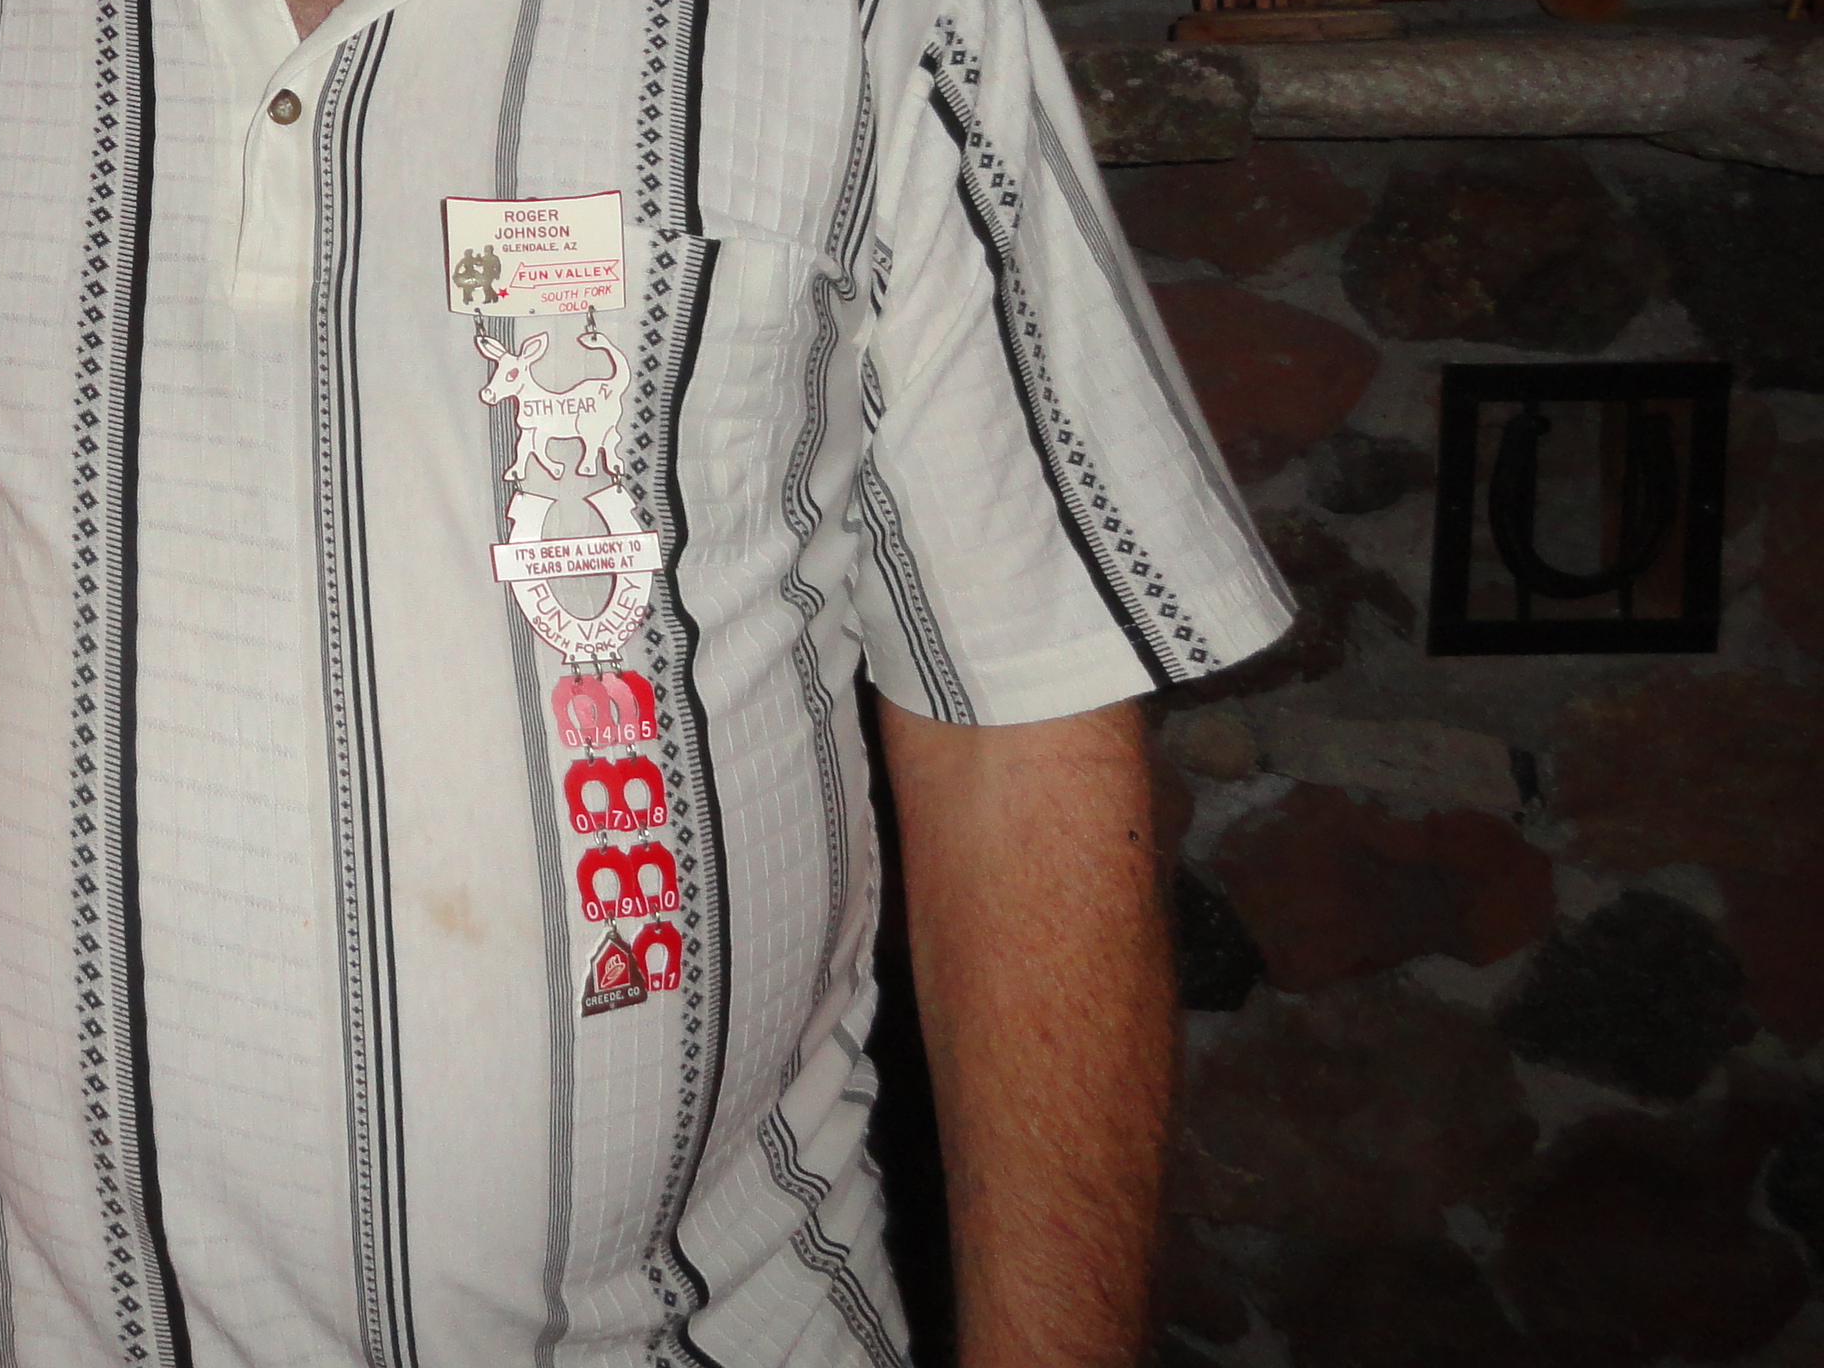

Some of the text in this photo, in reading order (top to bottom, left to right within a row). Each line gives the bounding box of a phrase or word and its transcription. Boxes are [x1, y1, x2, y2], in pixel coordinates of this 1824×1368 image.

[504, 209, 559, 223] ROGER
[495, 226, 570, 240] JOHNSON
[563, 242, 577, 251] AZ
[518, 265, 612, 281] FUN VALLEY
[541, 285, 612, 303] SOUTH FORK
[523, 397, 596, 417] 5TH YEAR
[515, 540, 641, 561] IT'S BEEN A LUCKY 10
[526, 556, 634, 575] YEARS DANCING AT
[528, 577, 641, 641] FUN VALLEY
[532, 616, 571, 649] SOUTH
[575, 634, 616, 654] FORK
